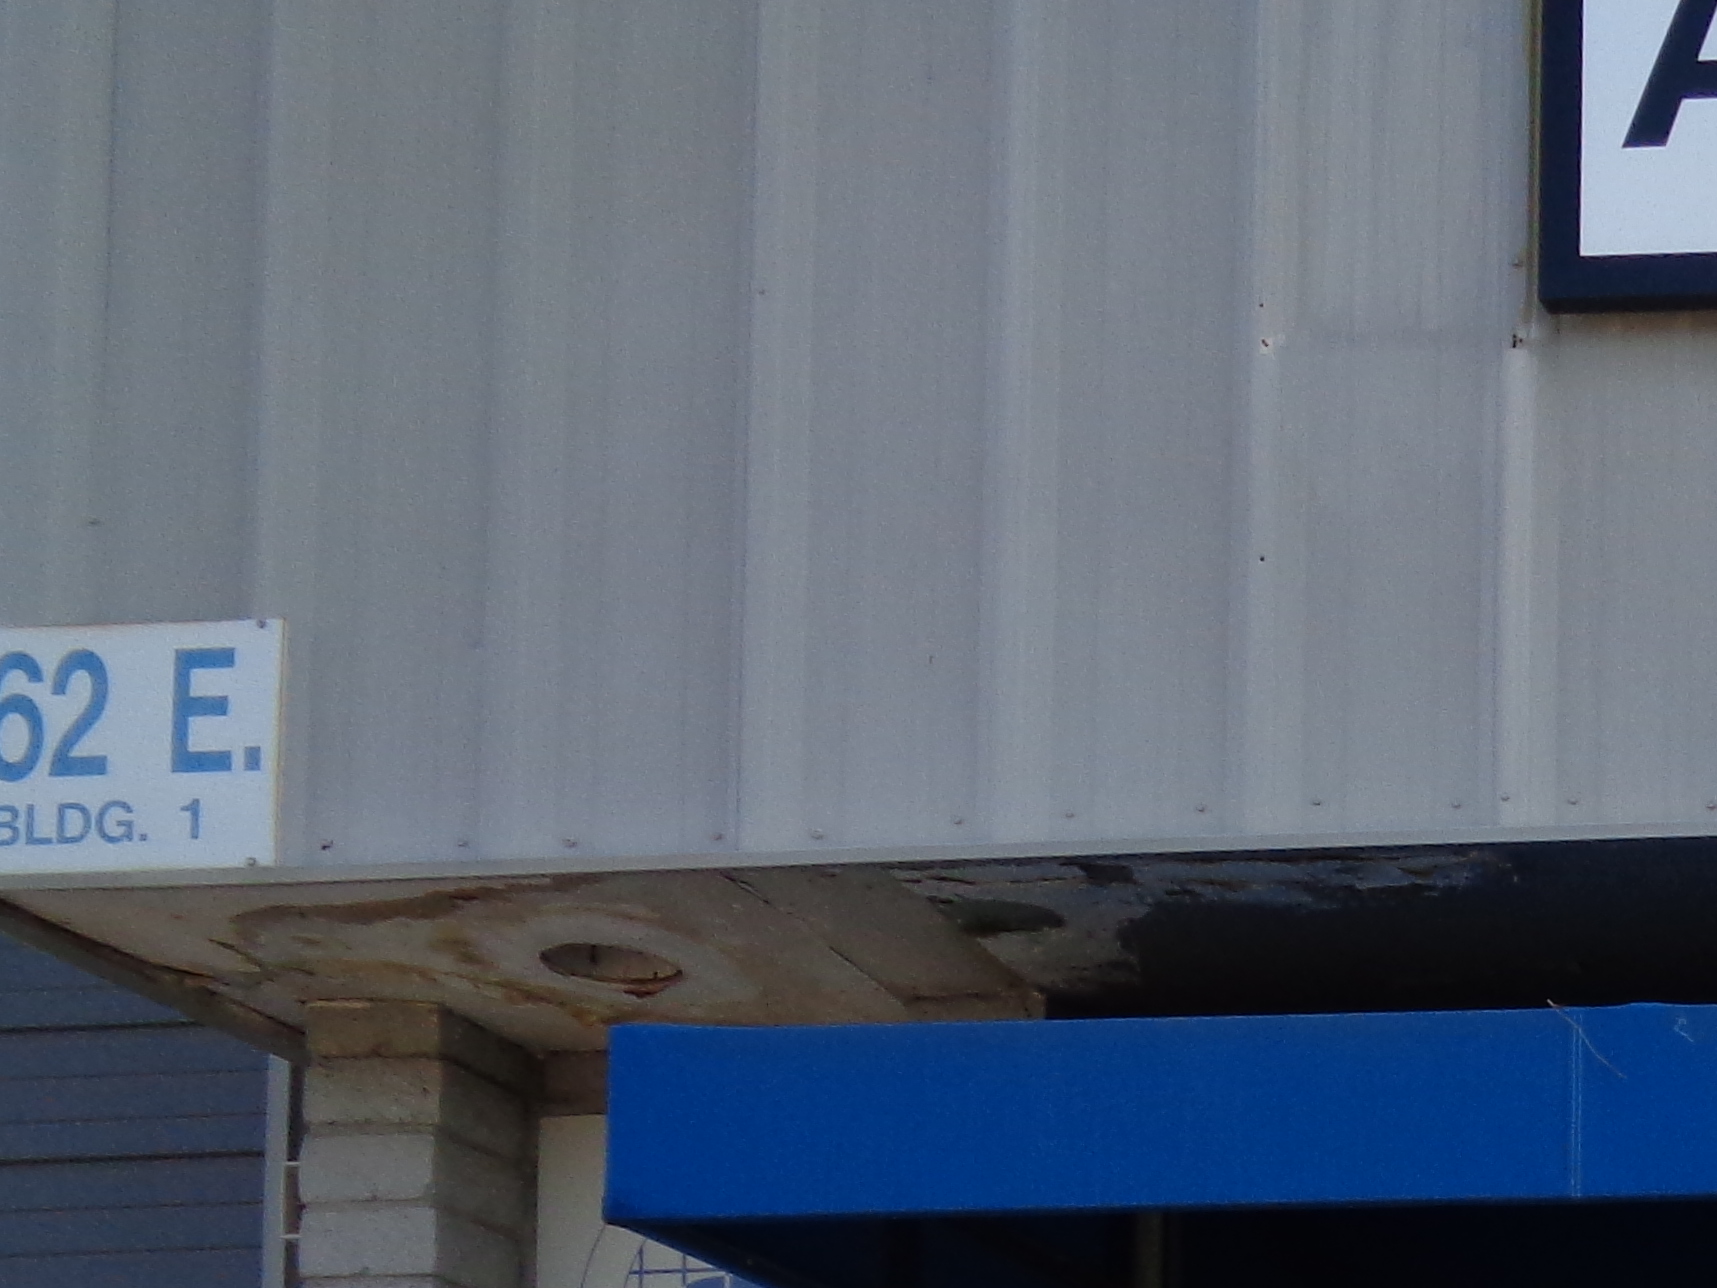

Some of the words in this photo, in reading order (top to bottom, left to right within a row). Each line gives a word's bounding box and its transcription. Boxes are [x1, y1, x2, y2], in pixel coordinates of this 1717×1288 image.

[171, 647, 261, 773] E.
[0, 801, 148, 846] BLDG.
[180, 799, 201, 840] 1
